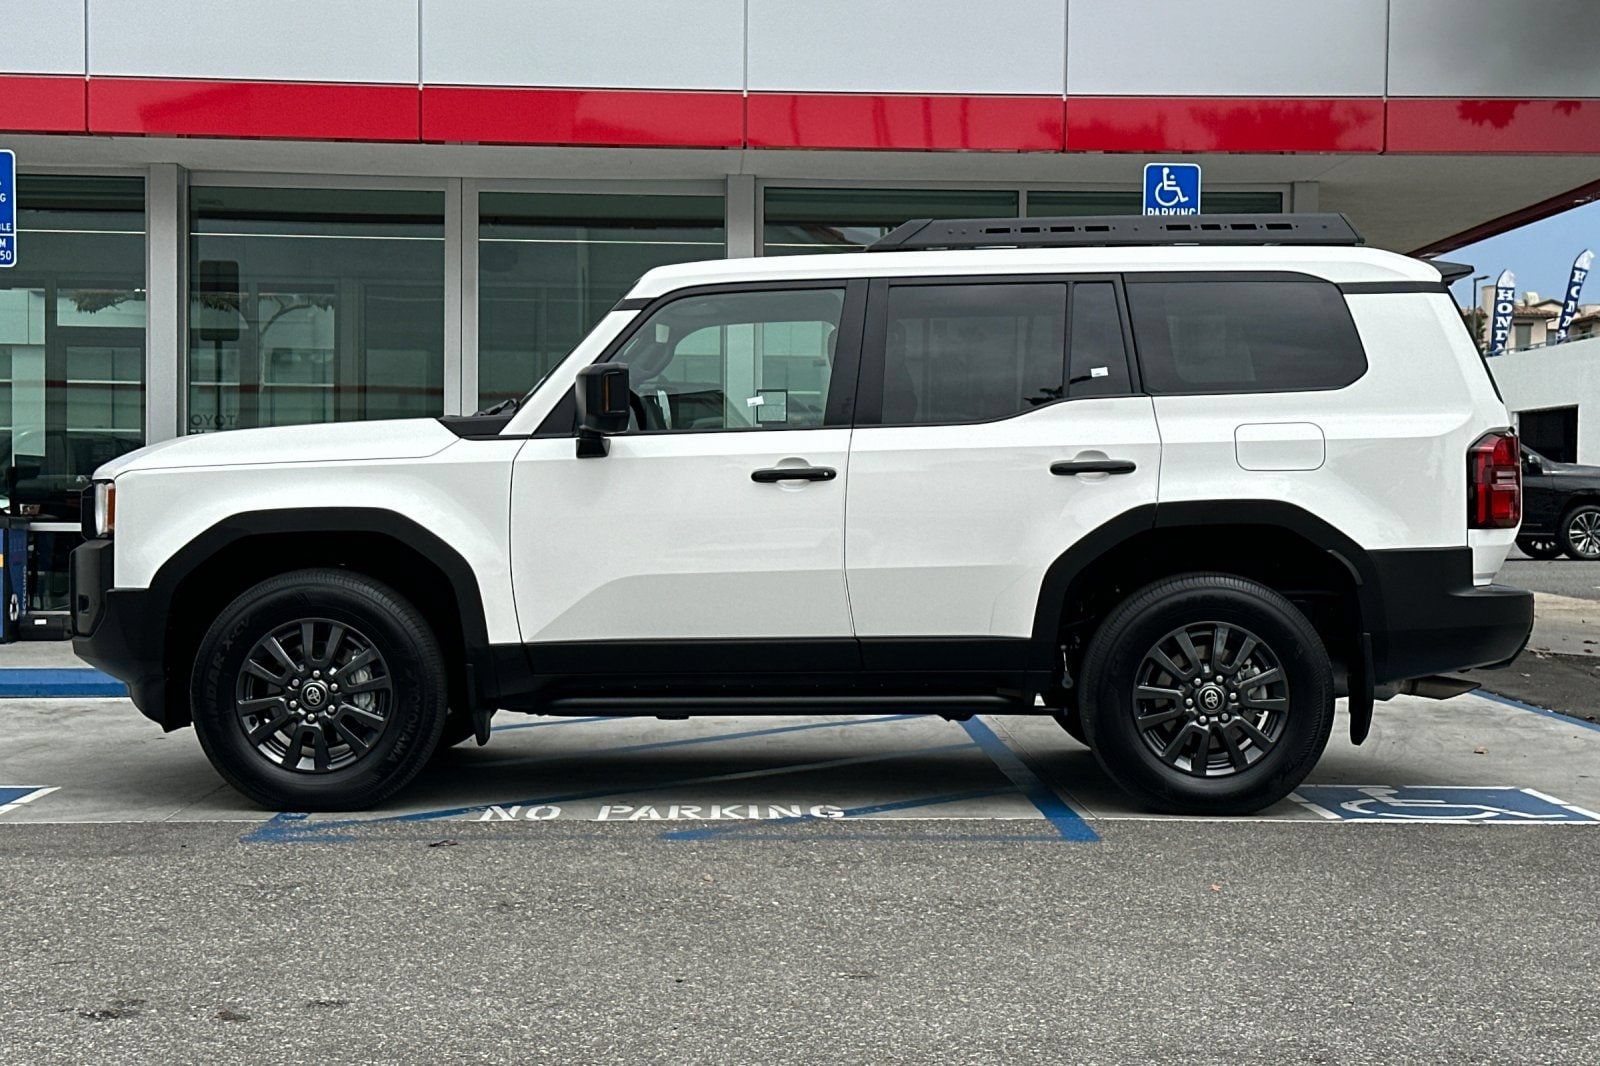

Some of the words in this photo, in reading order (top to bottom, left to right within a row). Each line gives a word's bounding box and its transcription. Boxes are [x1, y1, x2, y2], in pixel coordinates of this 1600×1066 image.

[1147, 207, 1196, 216] PARKING
[479, 805, 561, 821] NO
[597, 804, 844, 821] PARKING
